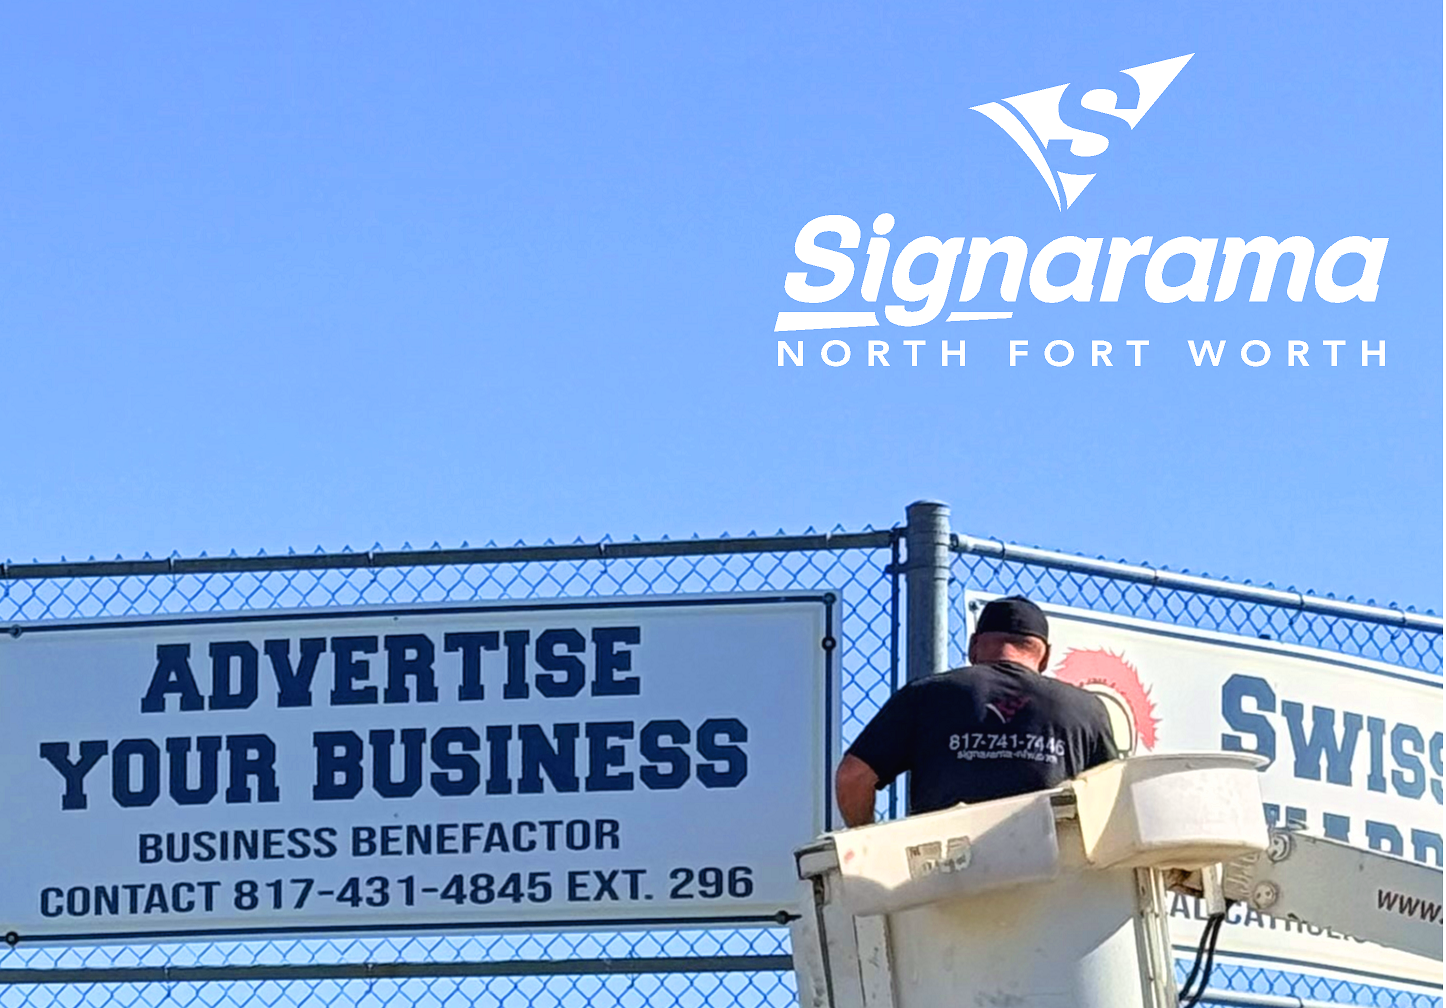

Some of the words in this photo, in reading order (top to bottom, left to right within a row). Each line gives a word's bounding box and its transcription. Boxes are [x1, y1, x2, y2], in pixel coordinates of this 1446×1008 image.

[141, 626, 641, 713] ADVERTISE
[40, 733, 280, 811] YOUR
[312, 718, 748, 800] BUSINESS
[949, 732, 1065, 756] 817-741-7446
[138, 825, 337, 864] BUSINESS
[351, 818, 620, 857] BENEFACTOR
[40, 880, 221, 918] CONTACT
[233, 871, 552, 911] 817-431-4845
[567, 867, 654, 904] EXT.
[669, 866, 754, 900] 296
